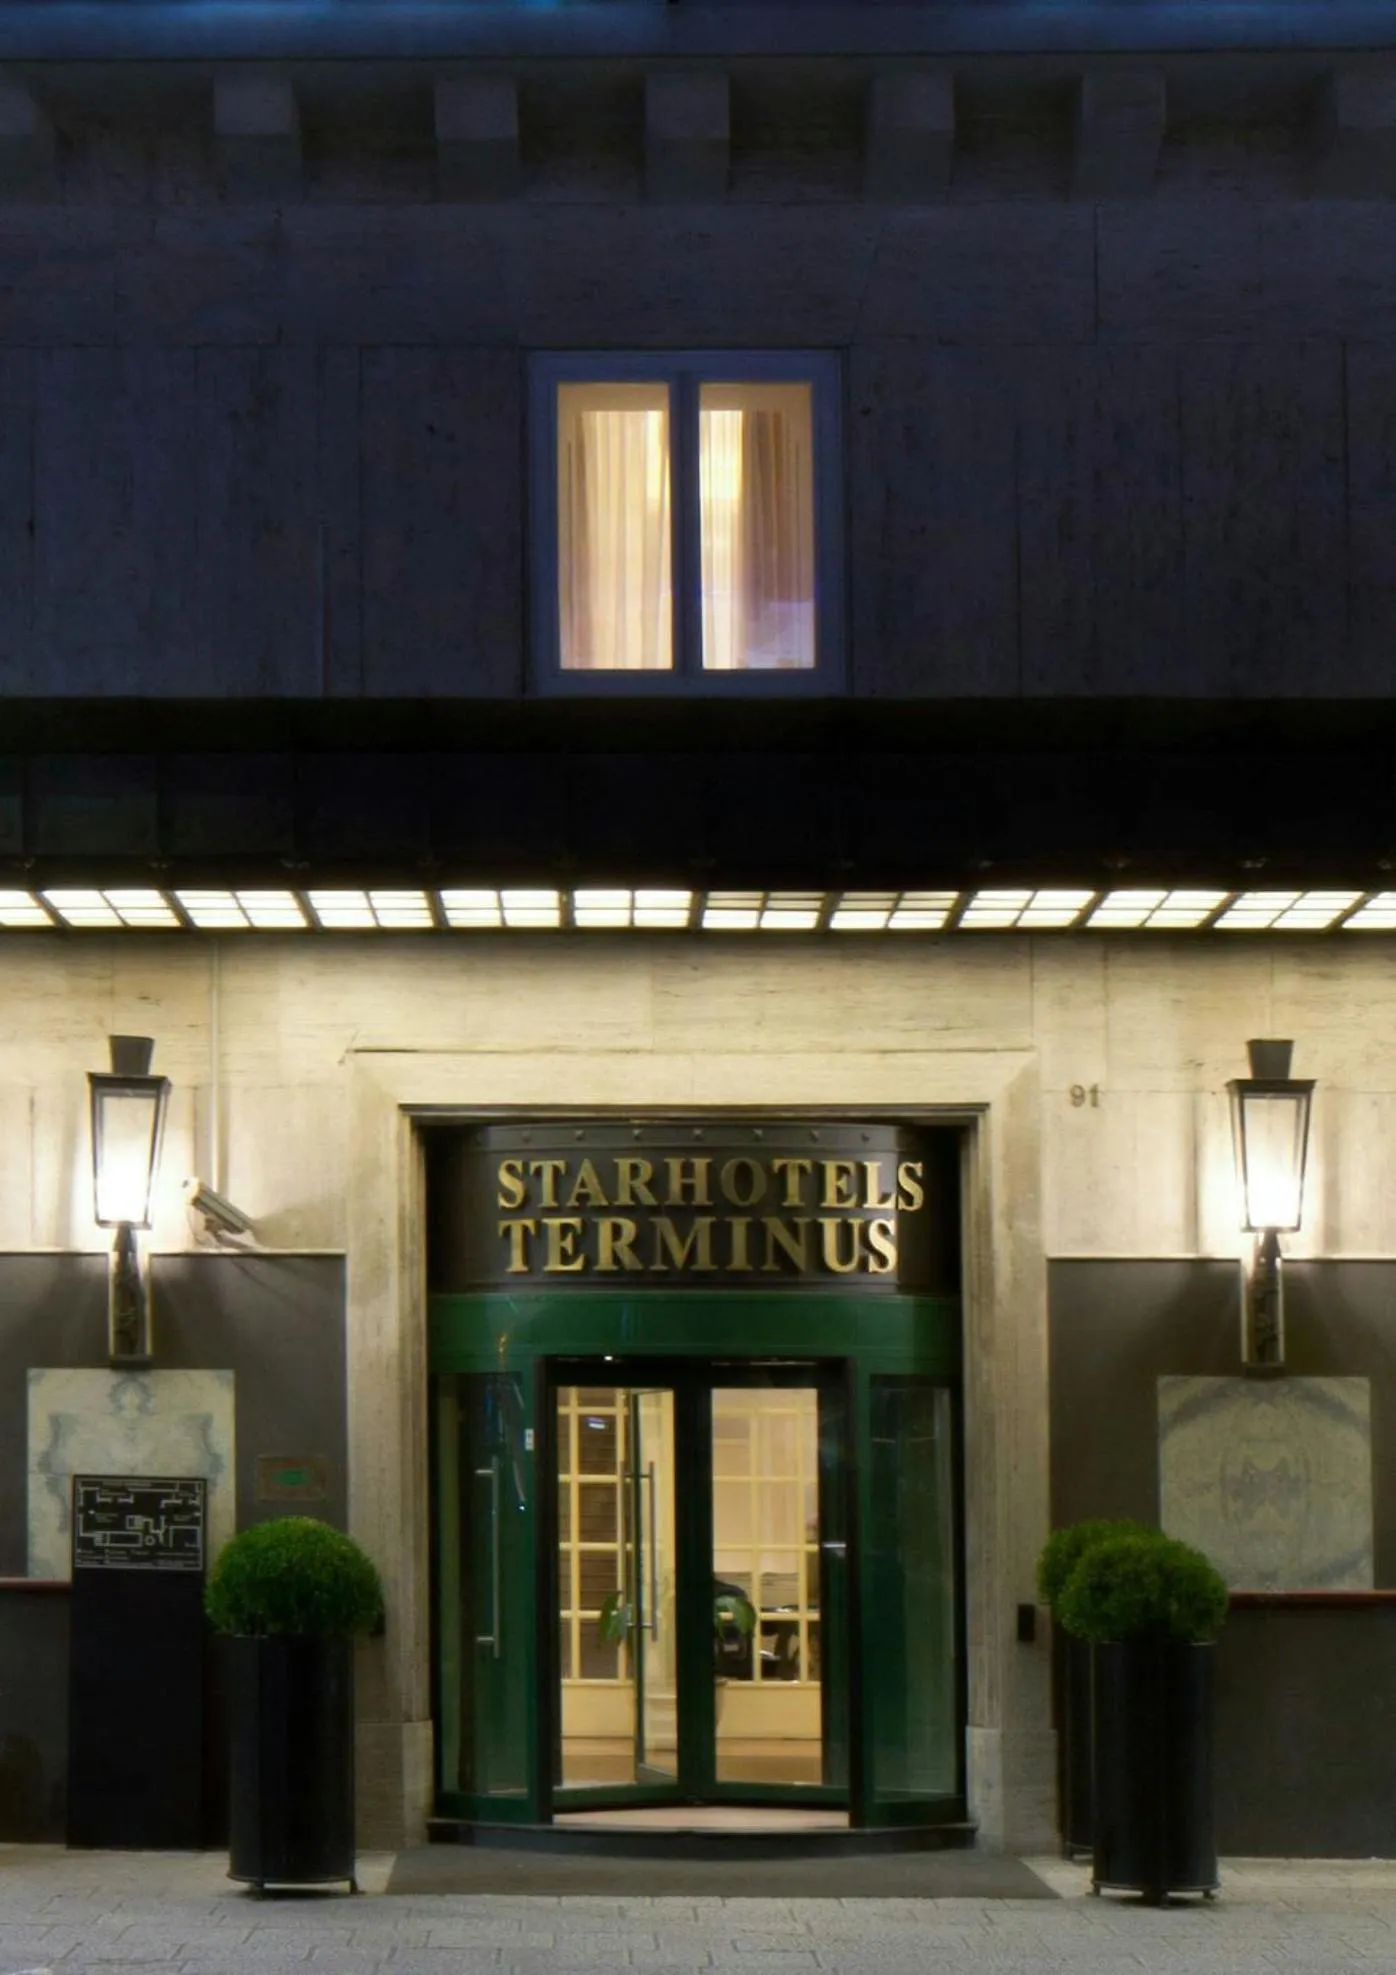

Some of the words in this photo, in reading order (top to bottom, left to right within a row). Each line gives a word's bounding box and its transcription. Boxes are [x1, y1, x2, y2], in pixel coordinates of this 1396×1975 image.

[1069, 1083, 1099, 1108] 91
[497, 1157, 925, 1212] STARHOTELS
[499, 1216, 898, 1274] TERMINUS
